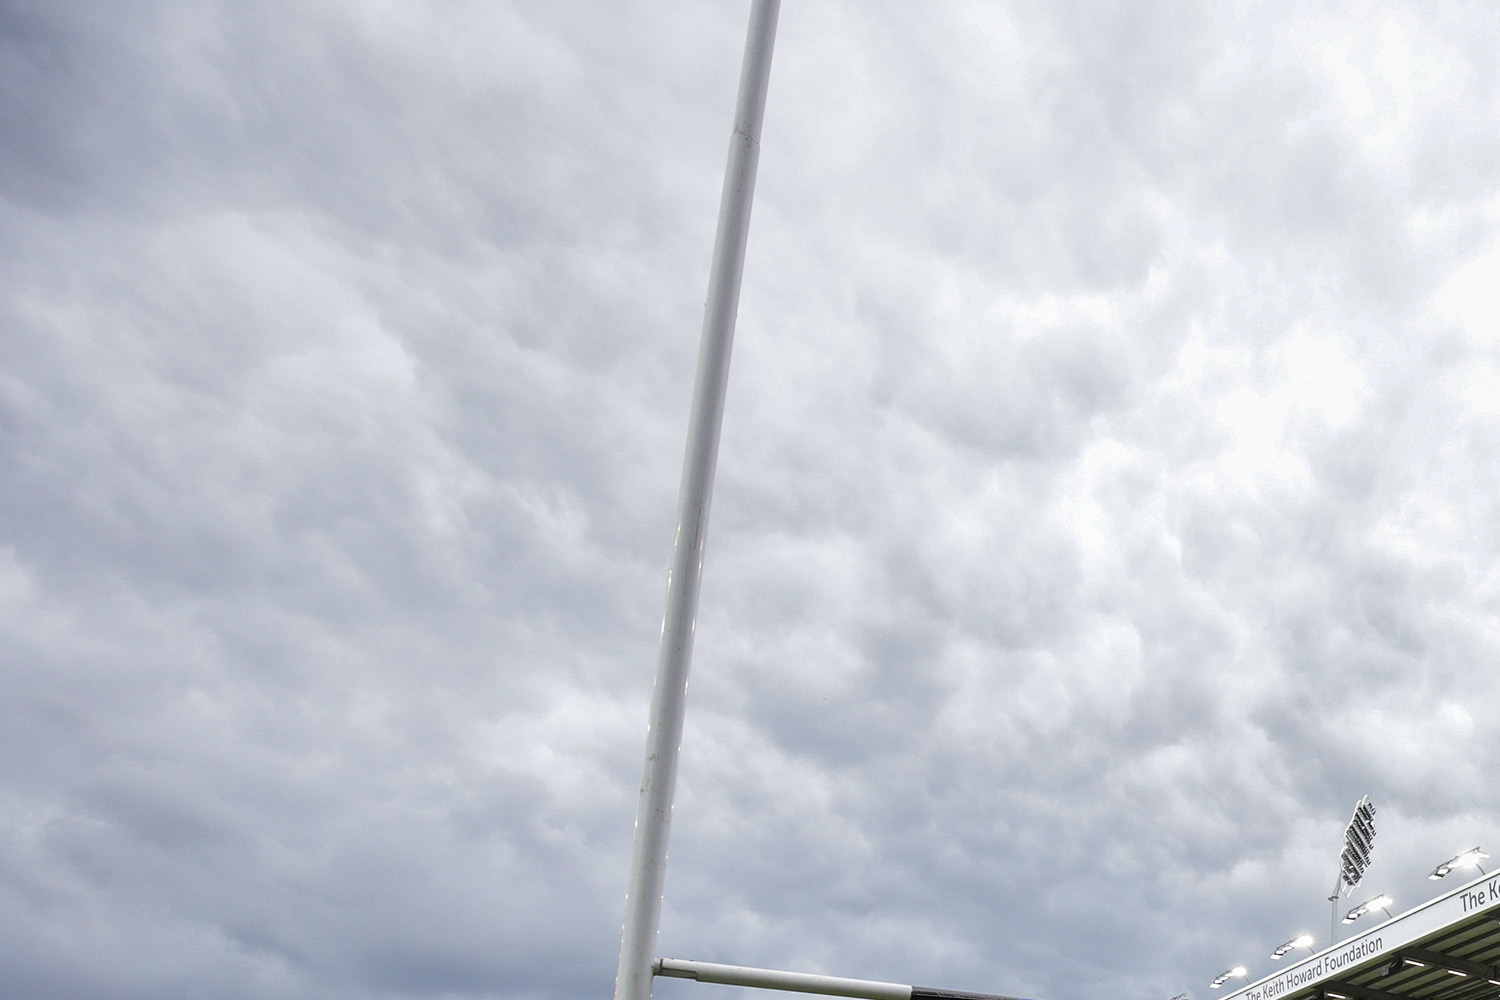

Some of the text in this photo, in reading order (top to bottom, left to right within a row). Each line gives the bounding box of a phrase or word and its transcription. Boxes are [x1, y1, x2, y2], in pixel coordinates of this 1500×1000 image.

[1460, 891, 1485, 913] The
[1262, 977, 1285, 999] Keith
[1286, 960, 1322, 990] Howard
[1325, 936, 1383, 974] Foundation
